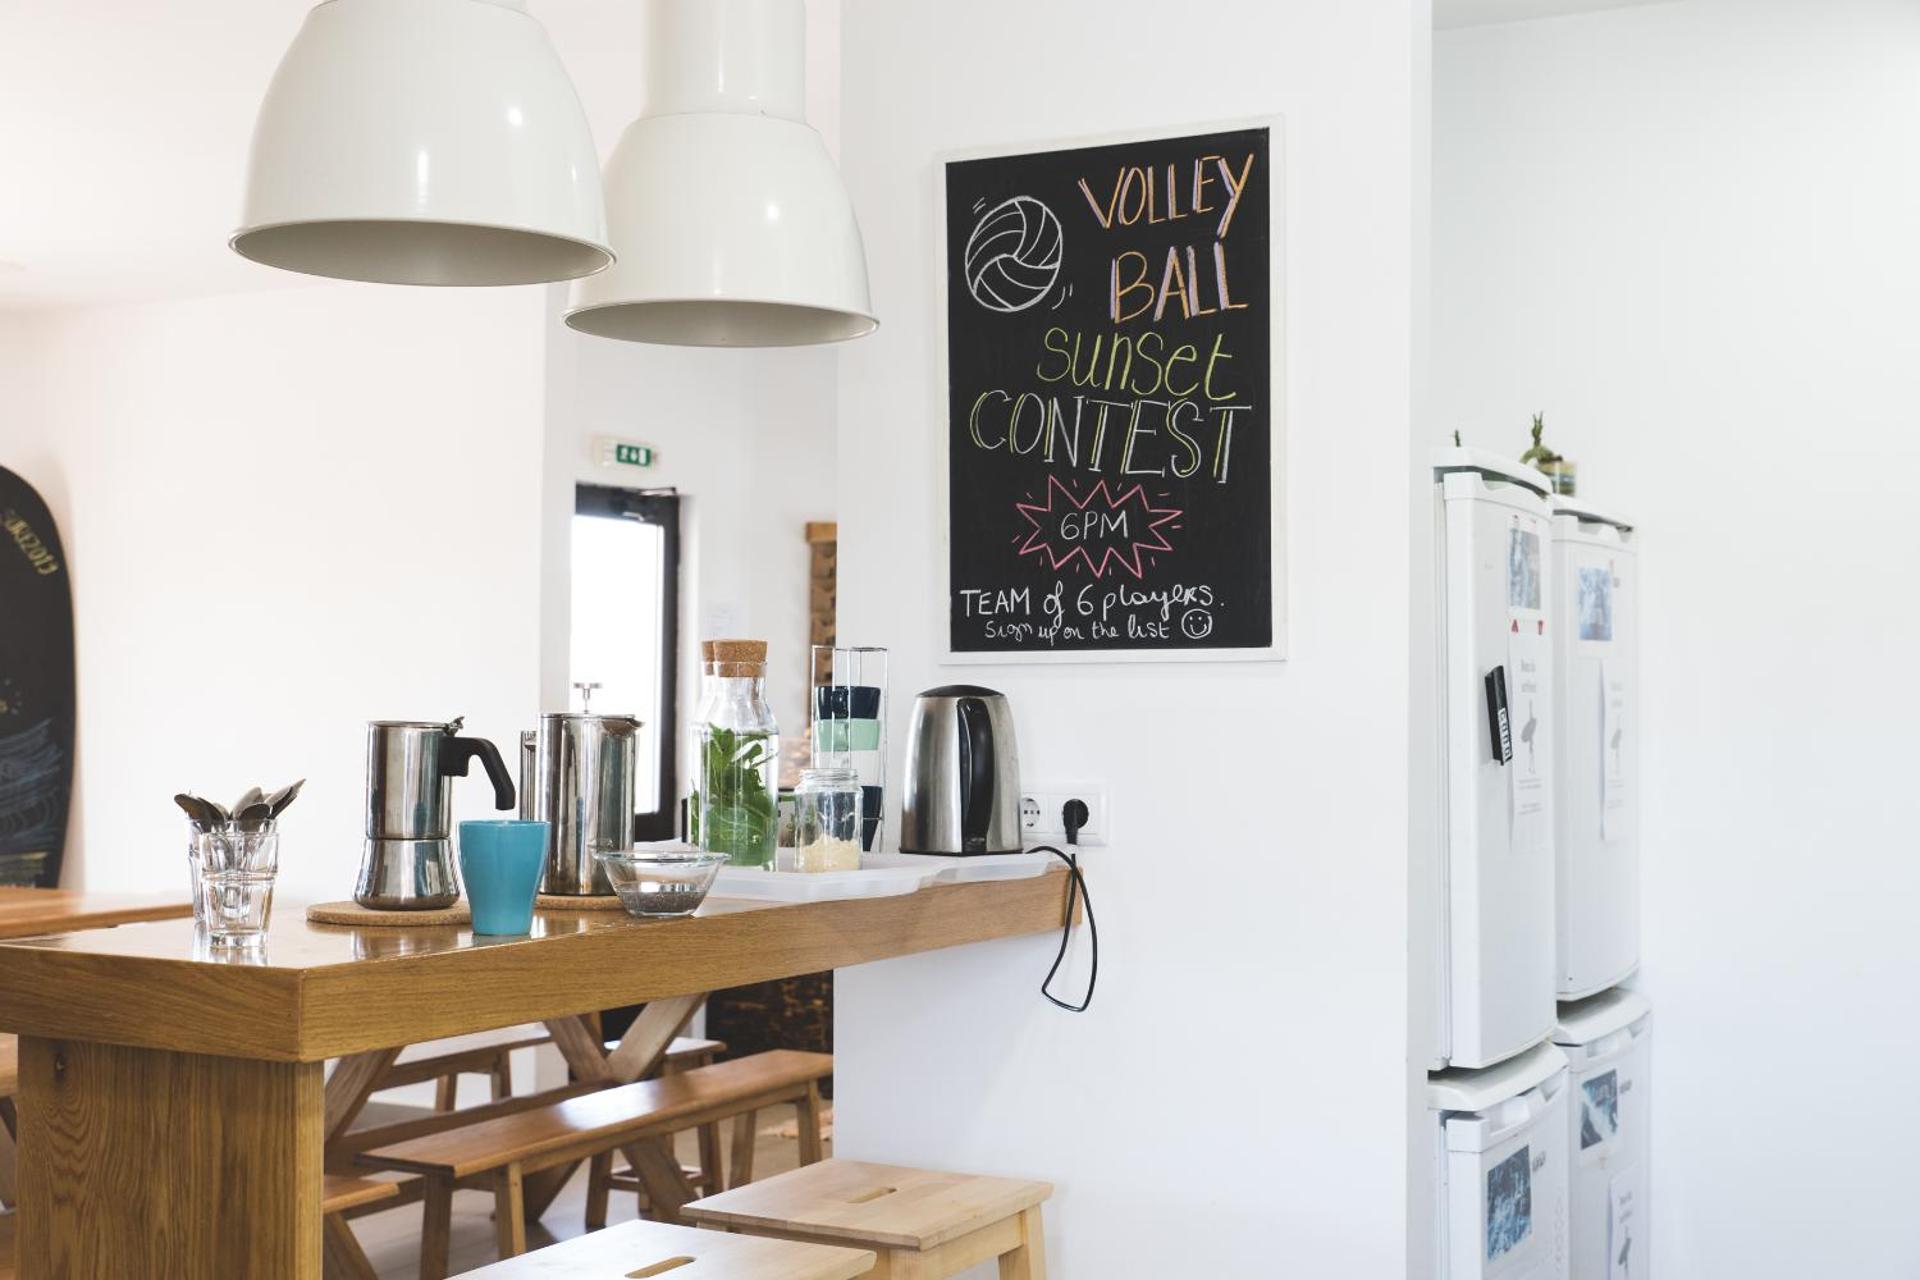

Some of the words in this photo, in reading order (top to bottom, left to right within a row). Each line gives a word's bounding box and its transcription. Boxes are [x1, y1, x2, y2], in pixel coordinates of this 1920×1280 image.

[1078, 153, 1254, 240] VOLLEY
[1110, 241, 1249, 324] BALL
[969, 389, 1252, 483] CONTEST
[1060, 509, 1129, 540] 6PM
[960, 586, 1031, 618] TEAM
[1043, 580, 1066, 628] of
[1076, 584, 1095, 616] 6
[984, 620, 1033, 642] Sign
[1038, 622, 1064, 646] up
[1063, 627, 1085, 640] on
[1091, 622, 1120, 639] the
[1127, 613, 1170, 639] list
